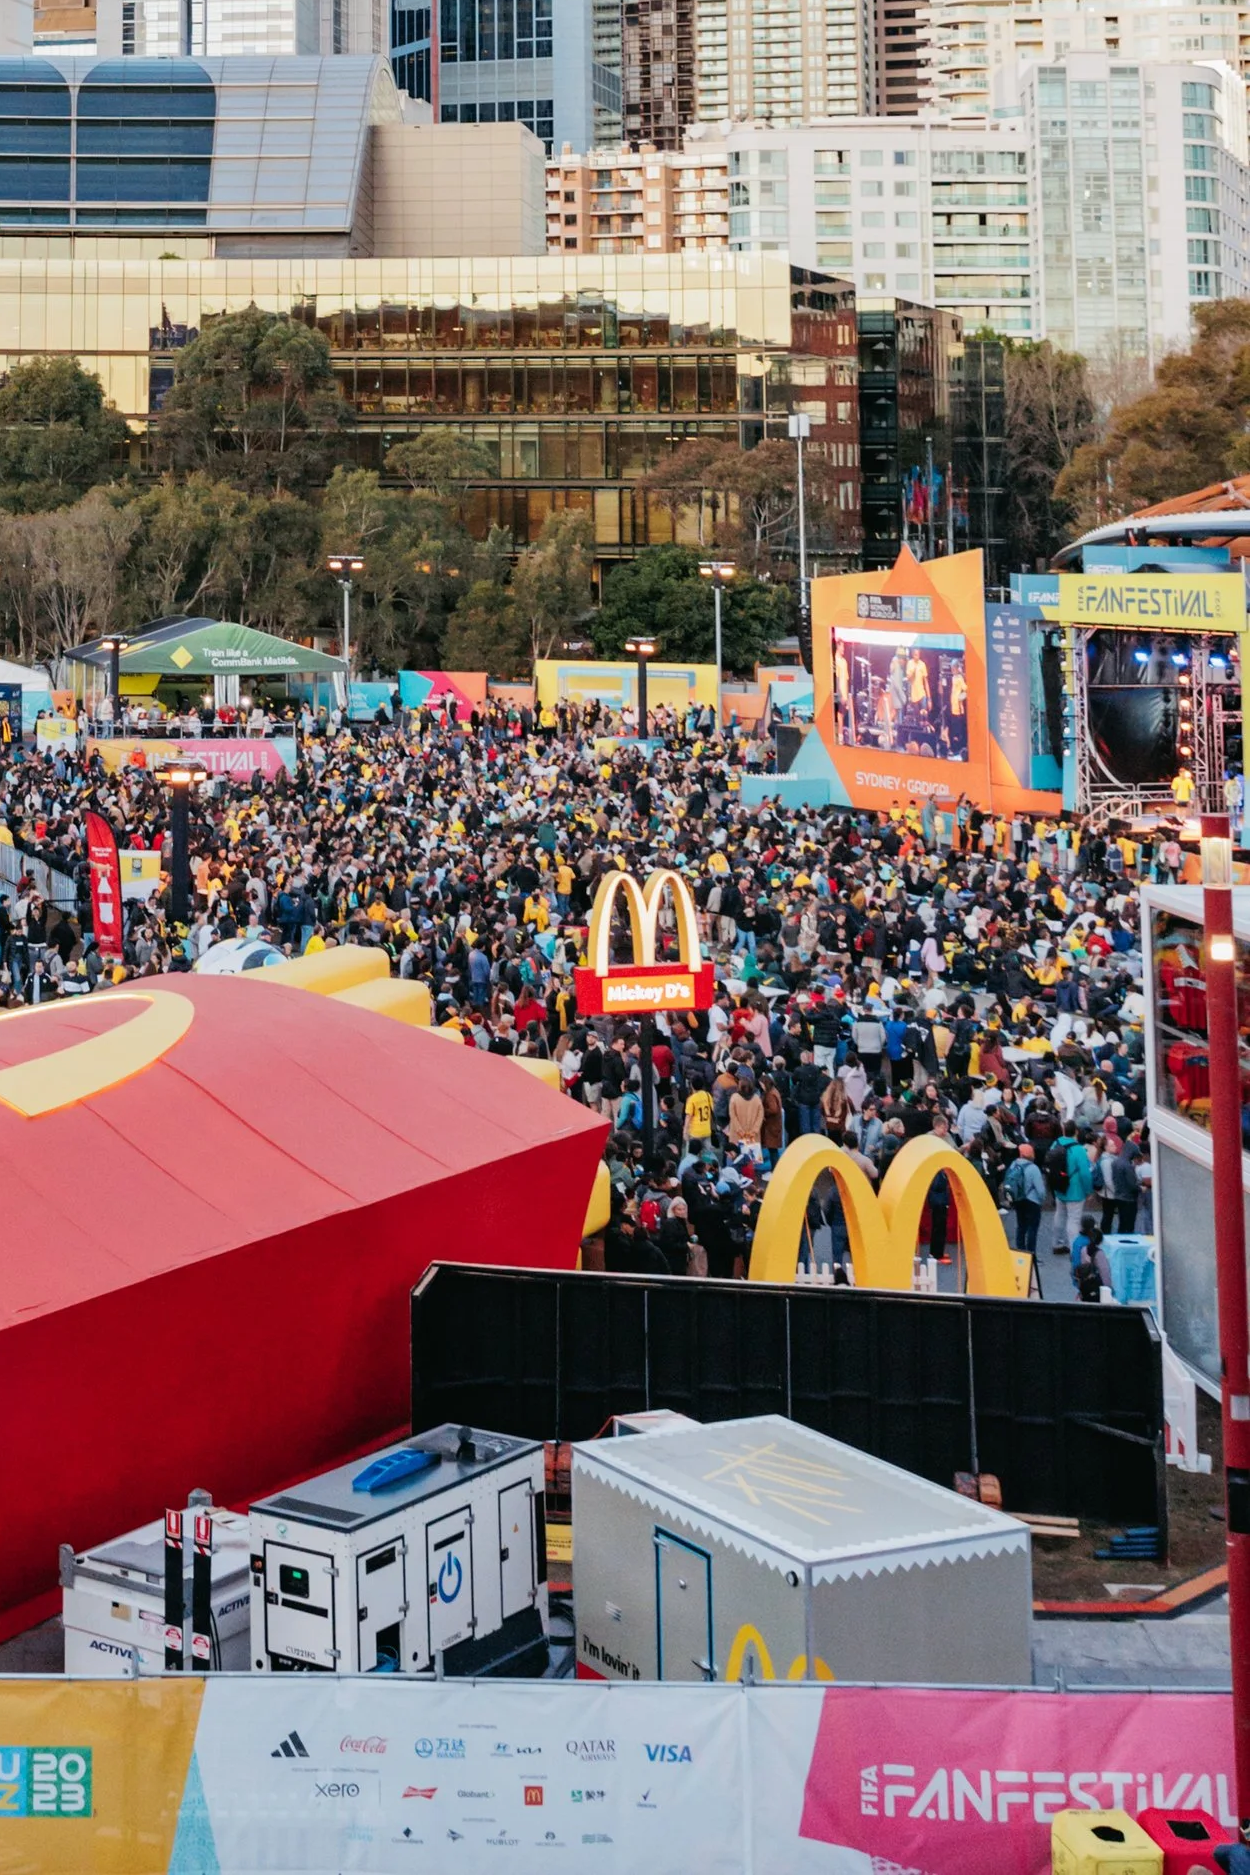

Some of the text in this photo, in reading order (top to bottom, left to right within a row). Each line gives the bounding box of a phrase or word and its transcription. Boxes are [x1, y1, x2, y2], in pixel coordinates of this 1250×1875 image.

[202, 648, 225, 657] Train
[226, 648, 241, 657] like
[211, 657, 262, 667] CommBank
[855, 771, 900, 790] SYDNEY
[607, 982, 690, 1004] Mickey D's
[698, 1105, 710, 1122] 13
[583, 1634, 600, 1659] i'm
[601, 1646, 631, 1677] lovin'
[436, 1751, 466, 1759] WANDA
[566, 1739, 616, 1756] QATAR
[643, 1743, 693, 1763] VISA
[579, 1754, 617, 1762] AIRWAYS
[32, 1753, 87, 1781] 20
[32, 1783, 86, 1812] 23
[315, 1782, 361, 1798] xero
[861, 1764, 879, 1817] FIFA
